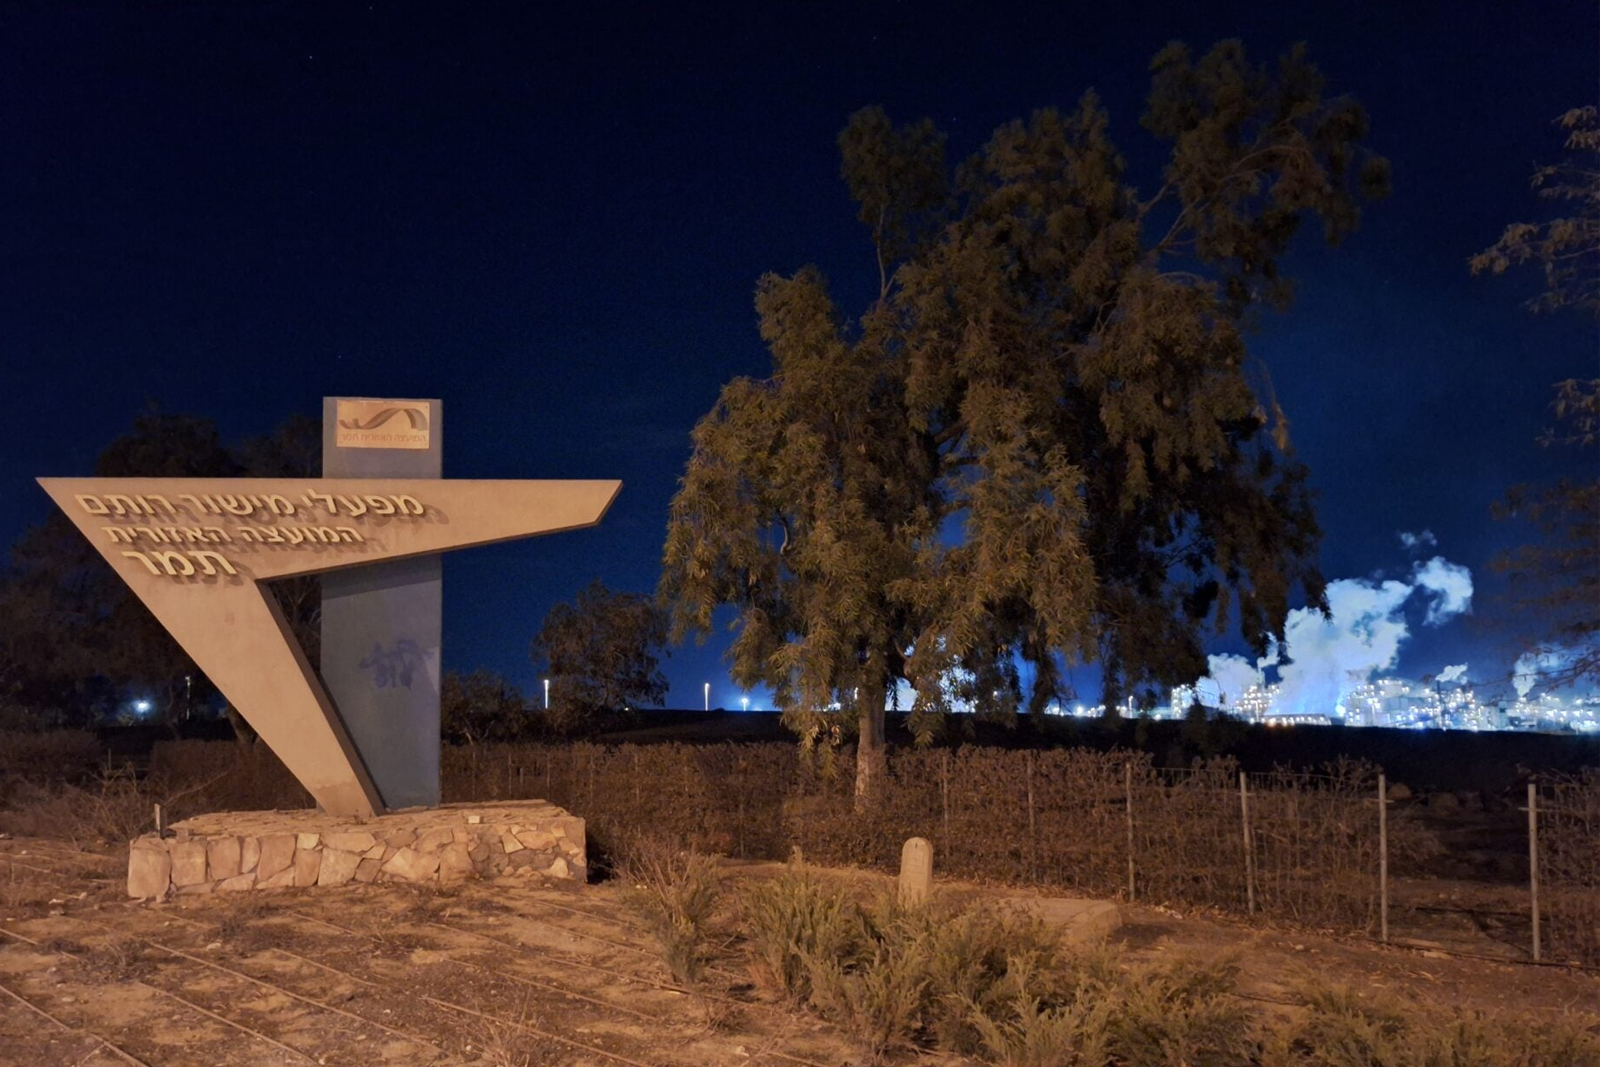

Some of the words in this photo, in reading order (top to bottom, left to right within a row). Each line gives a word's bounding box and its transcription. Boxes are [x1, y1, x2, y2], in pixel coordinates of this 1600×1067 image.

[75, 493, 178, 516] רותם
[178, 492, 297, 517] מישור
[302, 489, 425, 518] מפעלי
[101, 526, 232, 544] האזורית
[242, 526, 365, 544] המועצה
[121, 551, 238, 576] תמר
